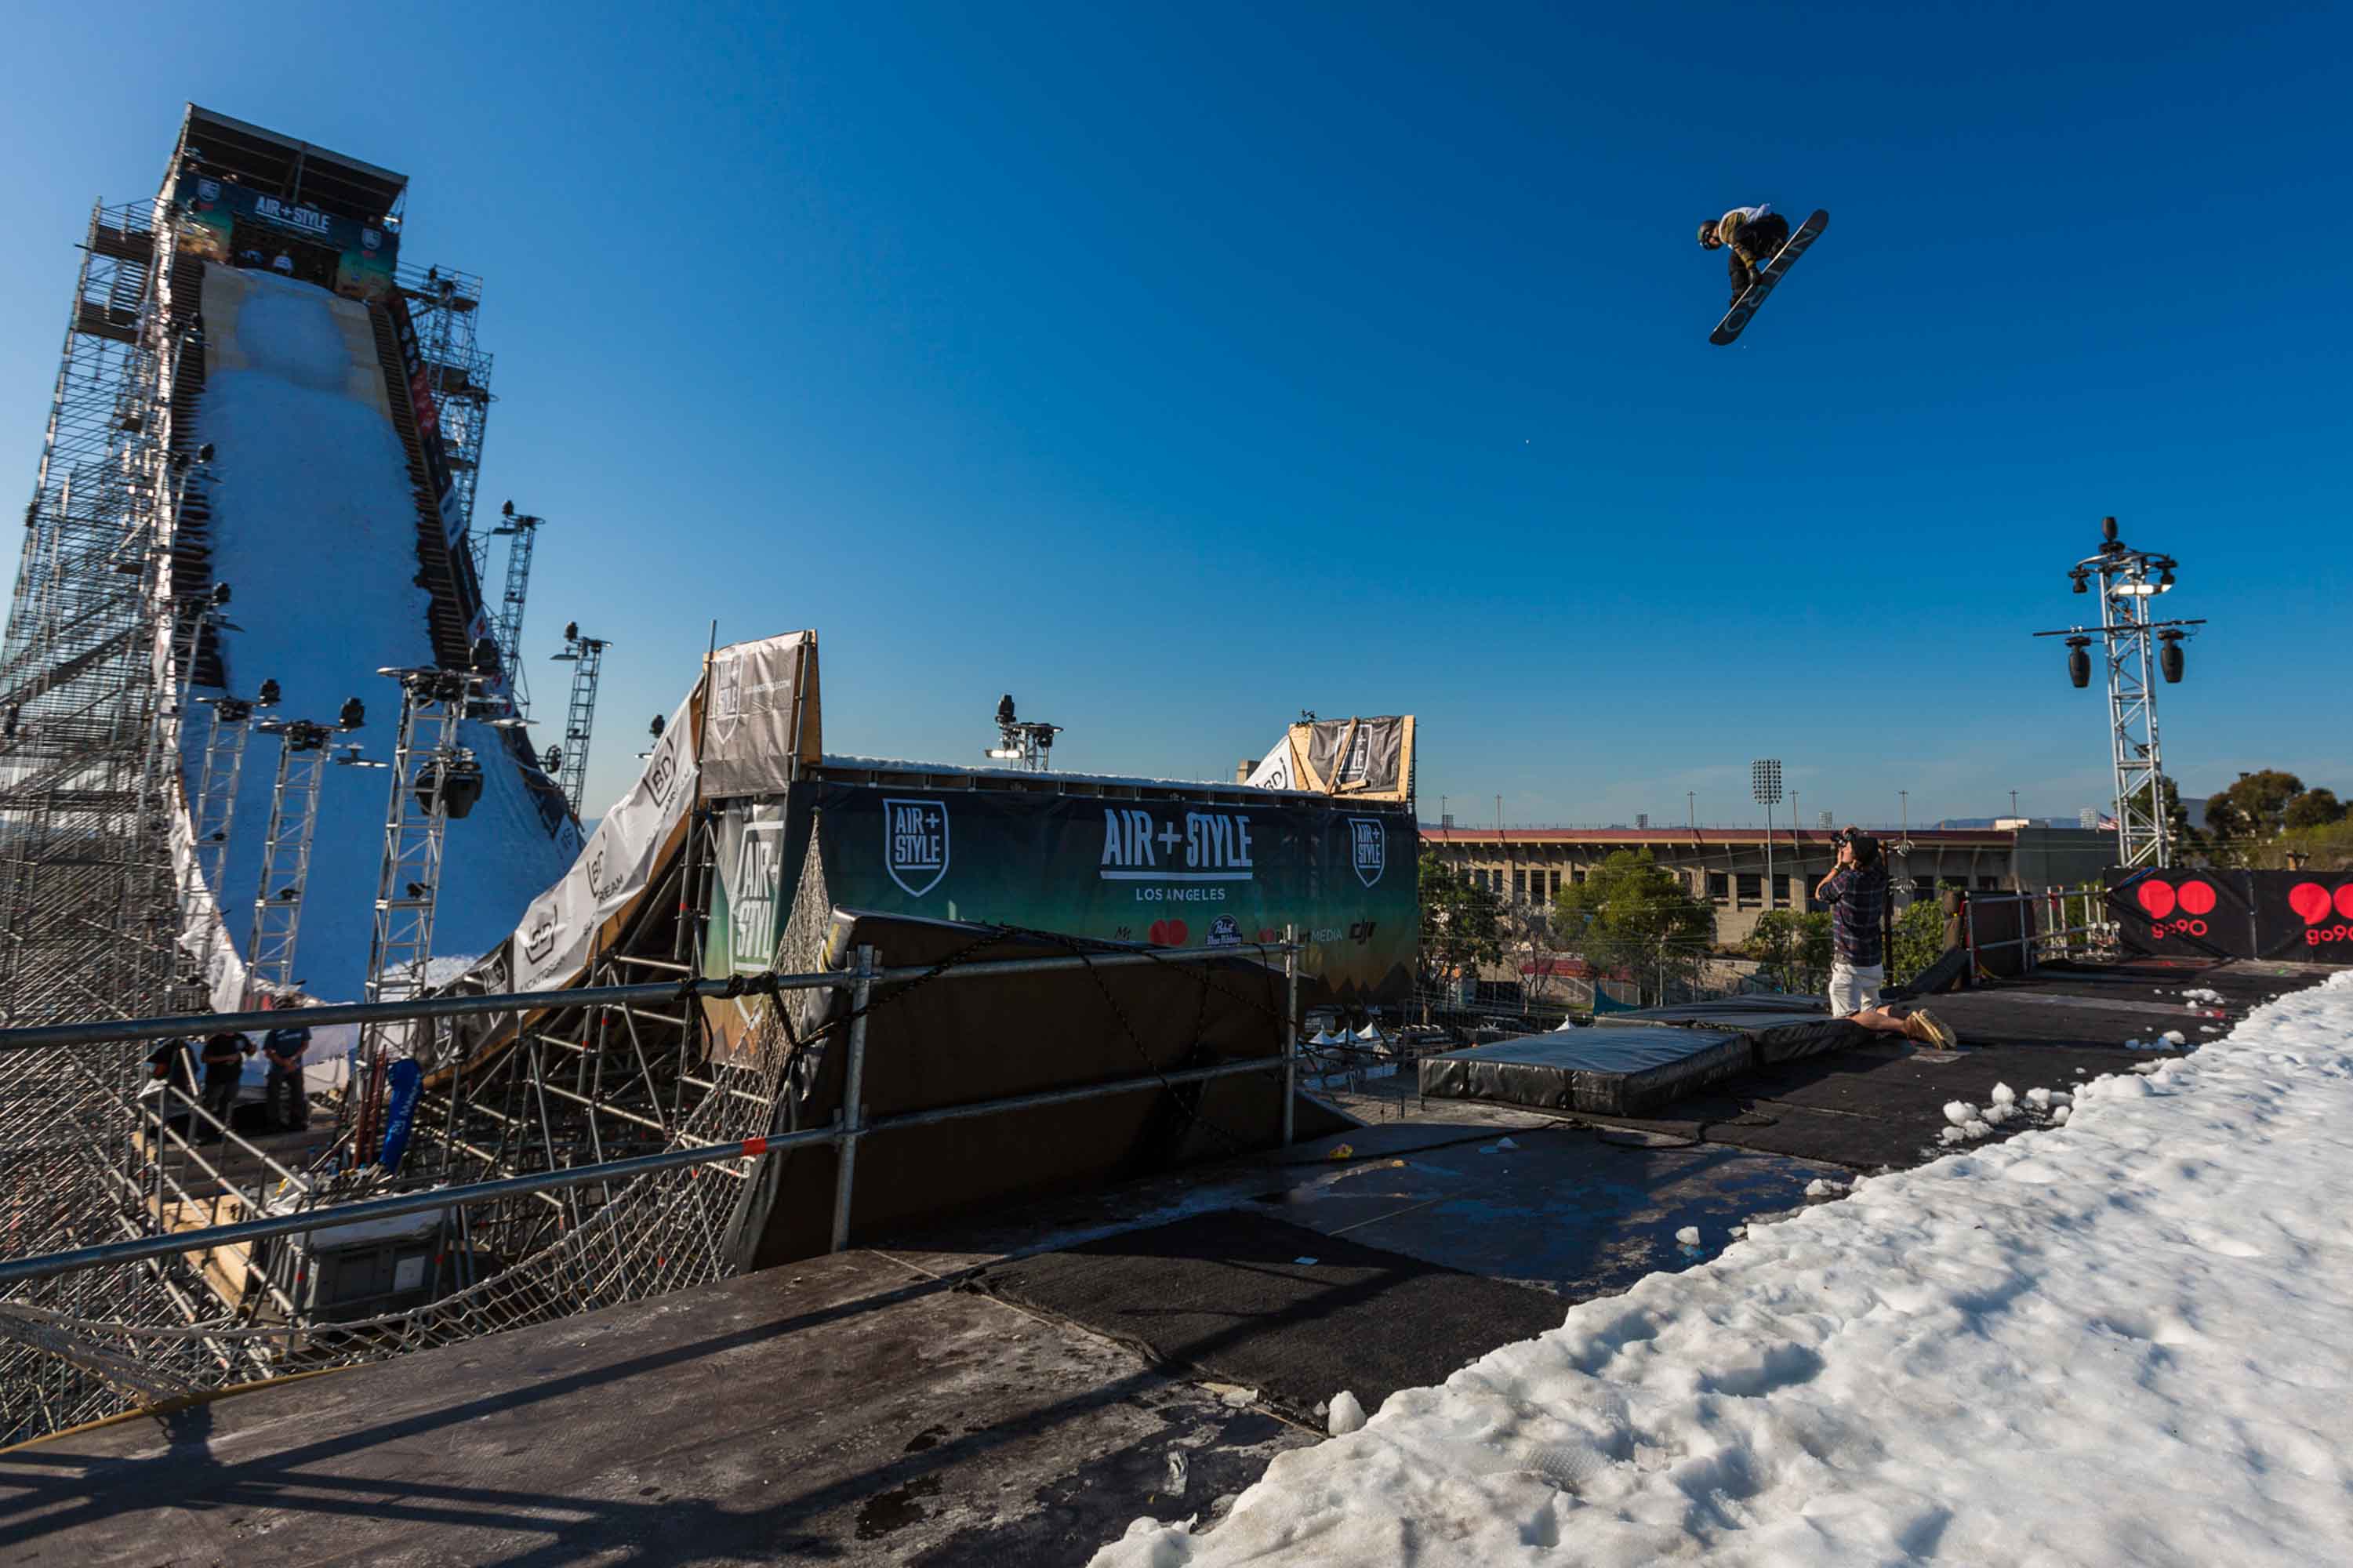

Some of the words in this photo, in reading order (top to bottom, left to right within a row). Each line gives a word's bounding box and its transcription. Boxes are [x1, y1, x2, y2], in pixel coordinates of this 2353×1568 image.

[895, 835, 941, 863] STYLE
[1358, 844, 1380, 863] STYLE
[1136, 887, 1163, 901] LOS
[1166, 887, 1226, 902] ANGELES
